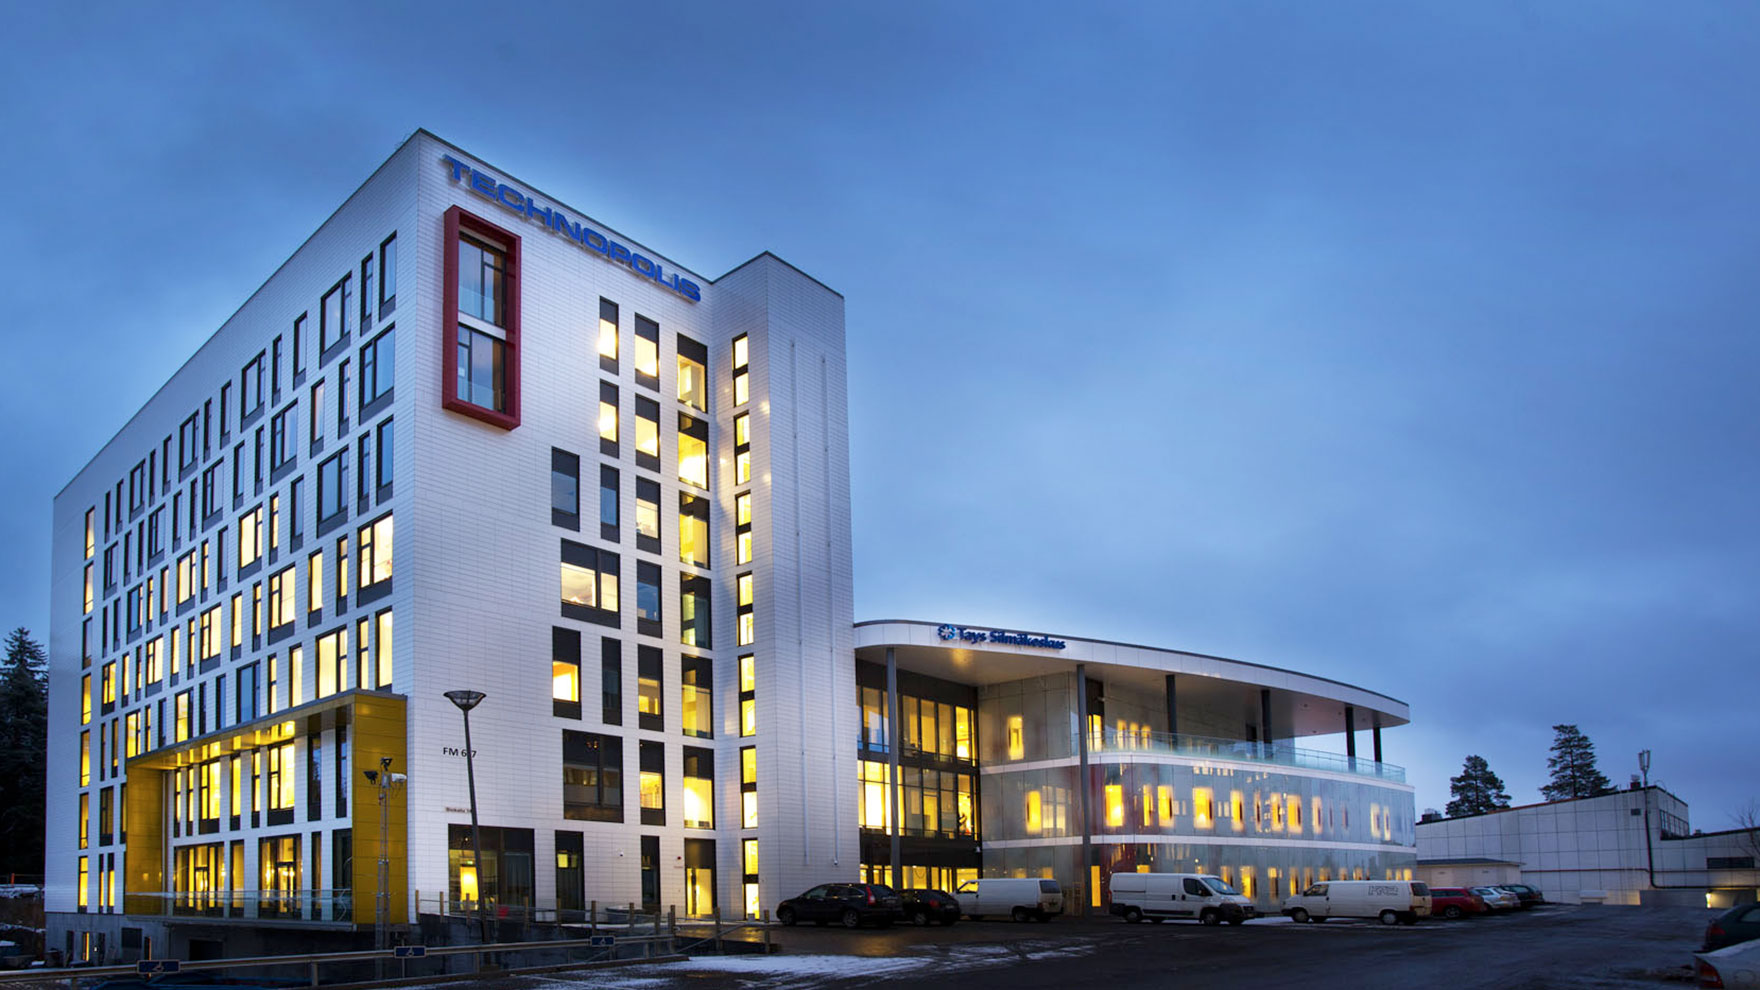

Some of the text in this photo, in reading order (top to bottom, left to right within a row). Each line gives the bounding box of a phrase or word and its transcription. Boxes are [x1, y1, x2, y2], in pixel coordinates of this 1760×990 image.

[443, 154, 701, 302] TECHNOPOLIS
[958, 627, 986, 644] Tays
[443, 747, 459, 757] FM
